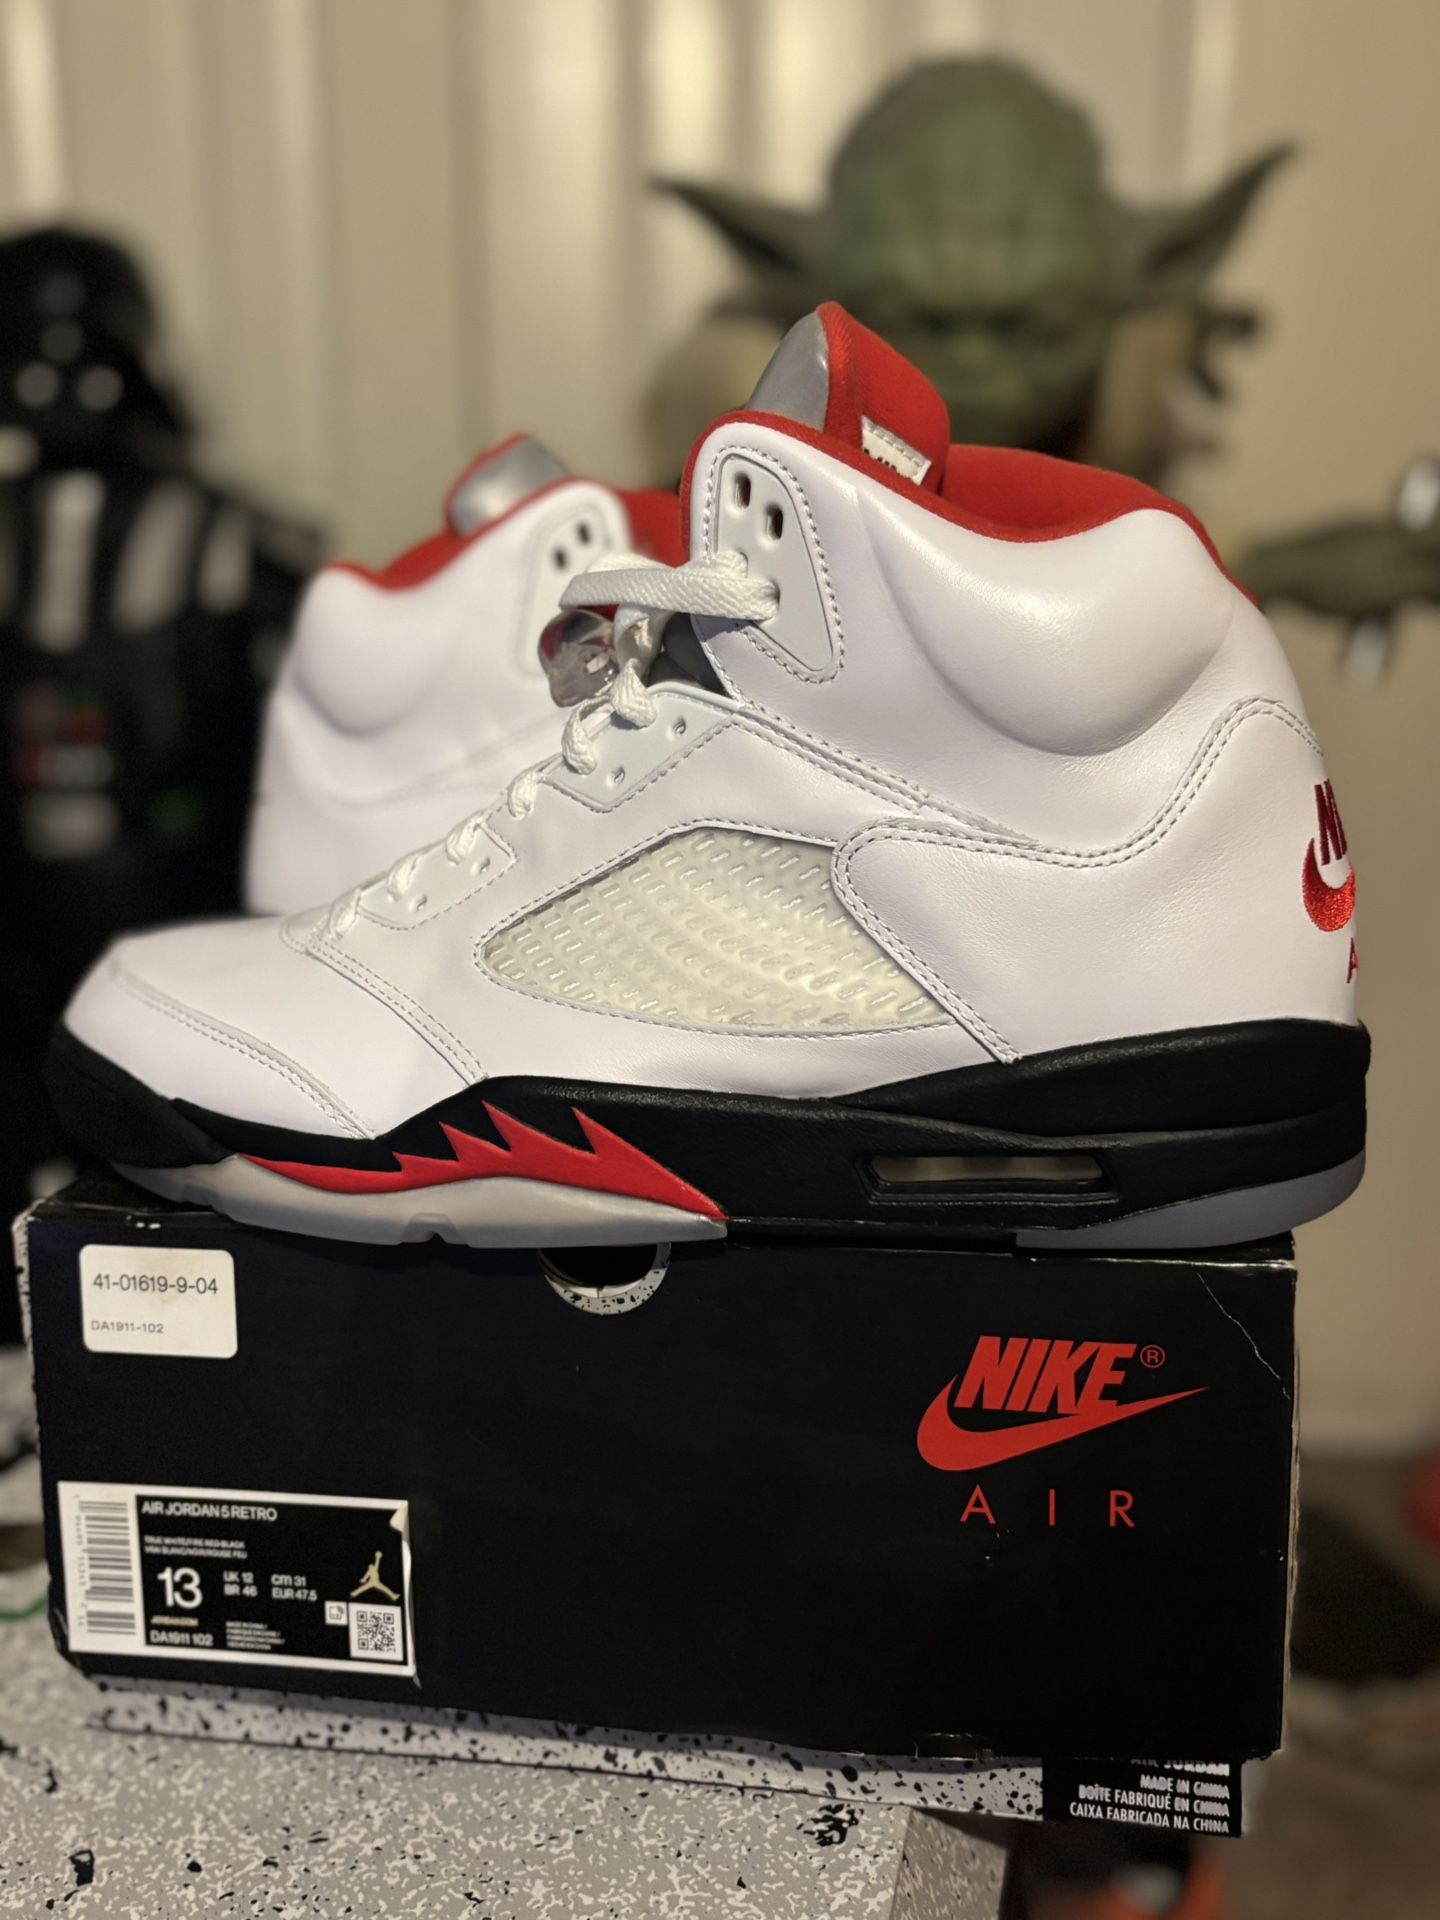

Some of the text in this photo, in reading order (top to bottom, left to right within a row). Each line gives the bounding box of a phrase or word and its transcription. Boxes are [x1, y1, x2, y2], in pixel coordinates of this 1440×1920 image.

[93, 1272, 218, 1295] 41-01619-9-04
[91, 1319, 164, 1334] DA1911-102
[954, 1335, 1138, 1415] NIKE
[142, 1500, 278, 1522] AIR JORDAN 5 RETRO
[959, 1484, 1136, 1528] AIR
[157, 1566, 204, 1609] 13
[223, 1570, 255, 1584] UK 12
[271, 1574, 307, 1587] cm 31
[223, 1584, 258, 1597] BR 46
[271, 1587, 318, 1602] EUR 47.5
[150, 1630, 191, 1645] DA1911
[191, 1632, 214, 1647] 102
[1140, 1774, 1174, 1793] MADE
[1176, 1778, 1190, 1794] IN
[1078, 1783, 1111, 1803] BOÎTE
[1114, 1789, 1171, 1810] FABRIQUÉ
[1174, 1797, 1190, 1812] EN
[1069, 1802, 1230, 1833] CAIXA FABRICADA NA CHINA
